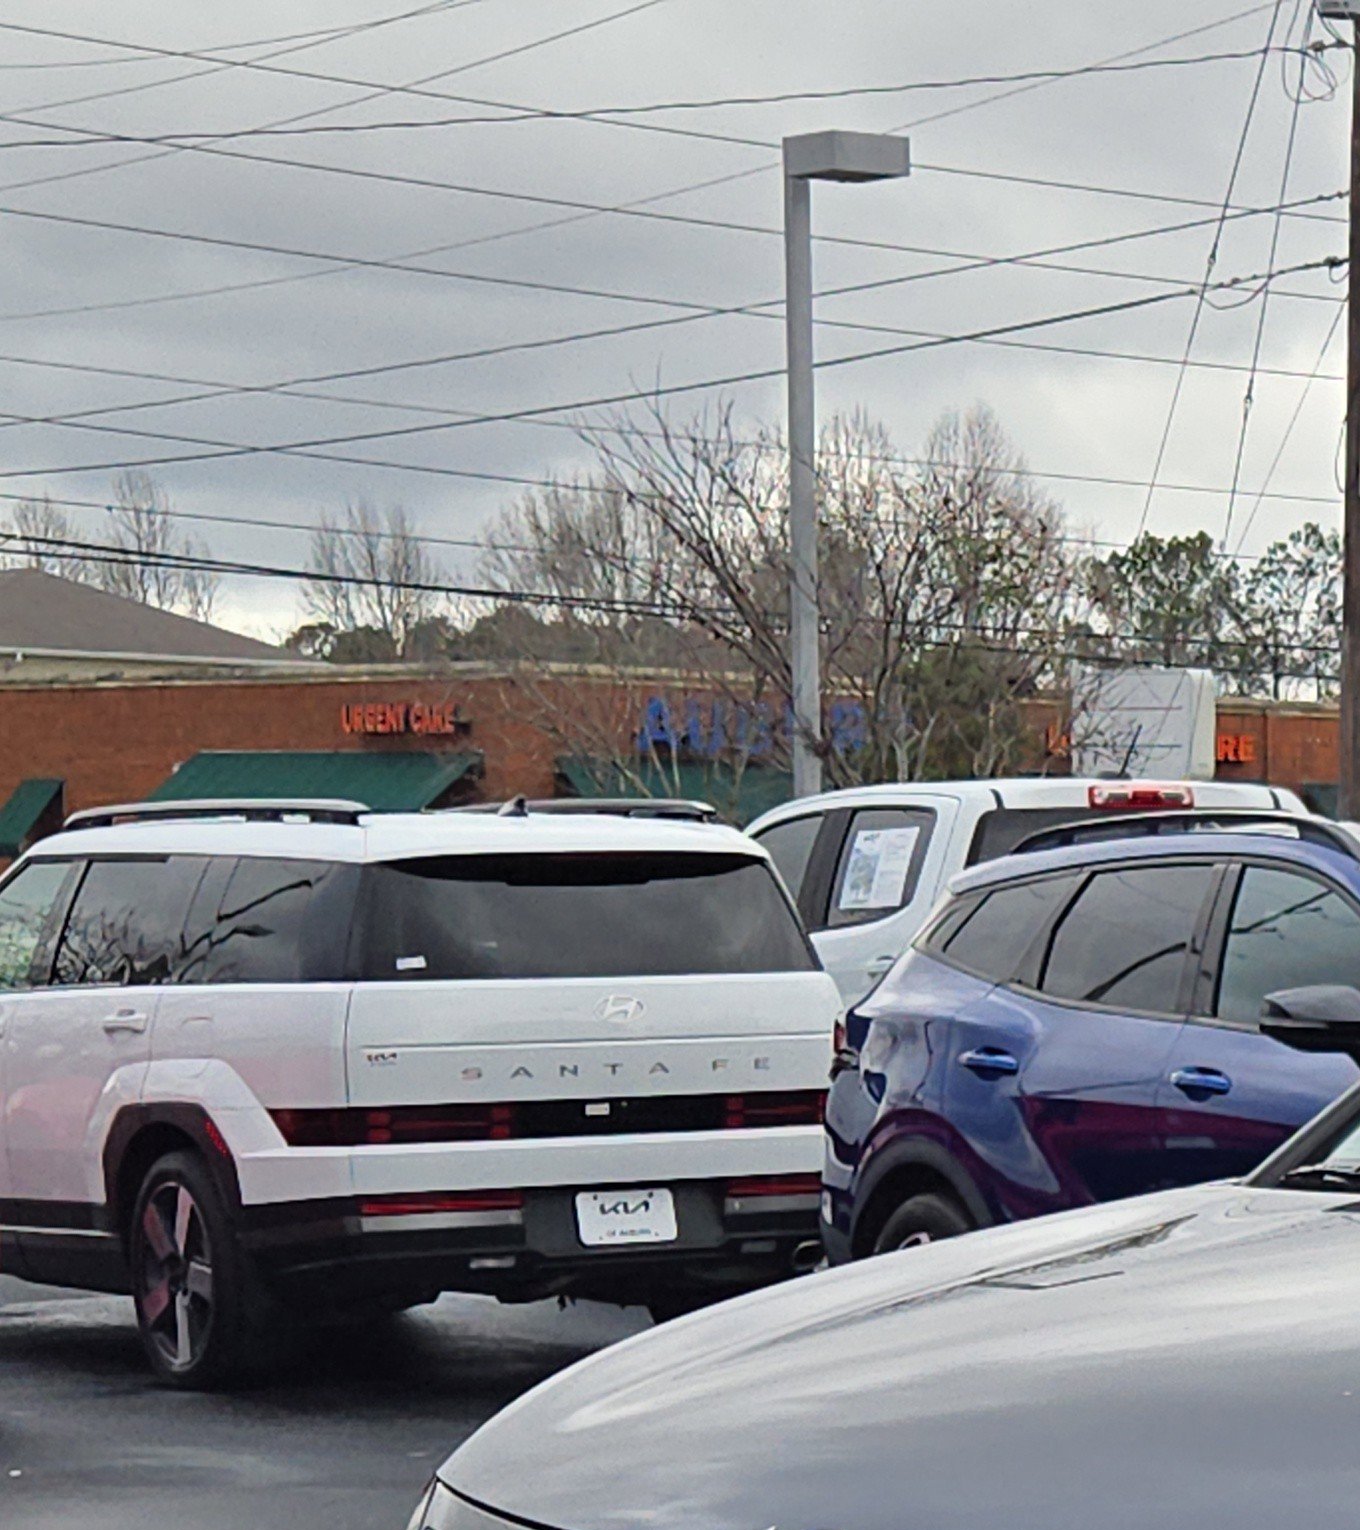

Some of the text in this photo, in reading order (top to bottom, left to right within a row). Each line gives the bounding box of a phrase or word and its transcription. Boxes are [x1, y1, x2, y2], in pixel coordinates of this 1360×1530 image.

[341, 702, 456, 735] URGENT CARE
[1216, 733, 1256, 762] RE
[461, 1057, 771, 1080] SANTA FE
[599, 1199, 650, 1215] KIA
